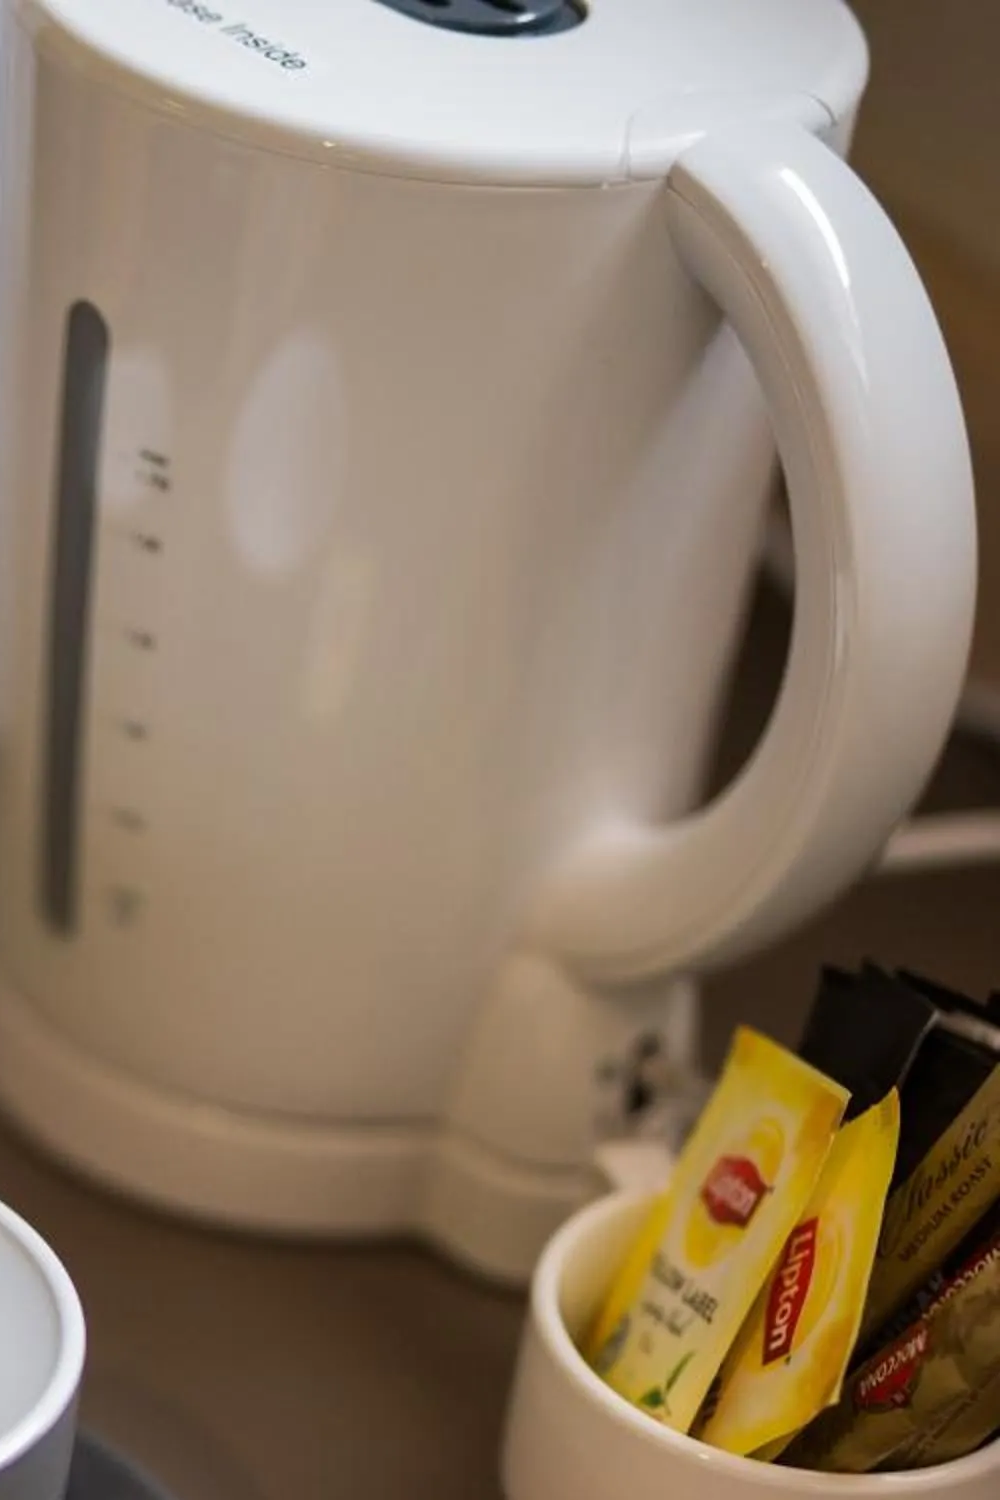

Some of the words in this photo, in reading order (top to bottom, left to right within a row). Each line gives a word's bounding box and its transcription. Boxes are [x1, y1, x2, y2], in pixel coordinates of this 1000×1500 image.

[219, 23, 306, 70] Inside
[949, 1154, 993, 1207] ROAST
[768, 1231, 813, 1350] Lipton
